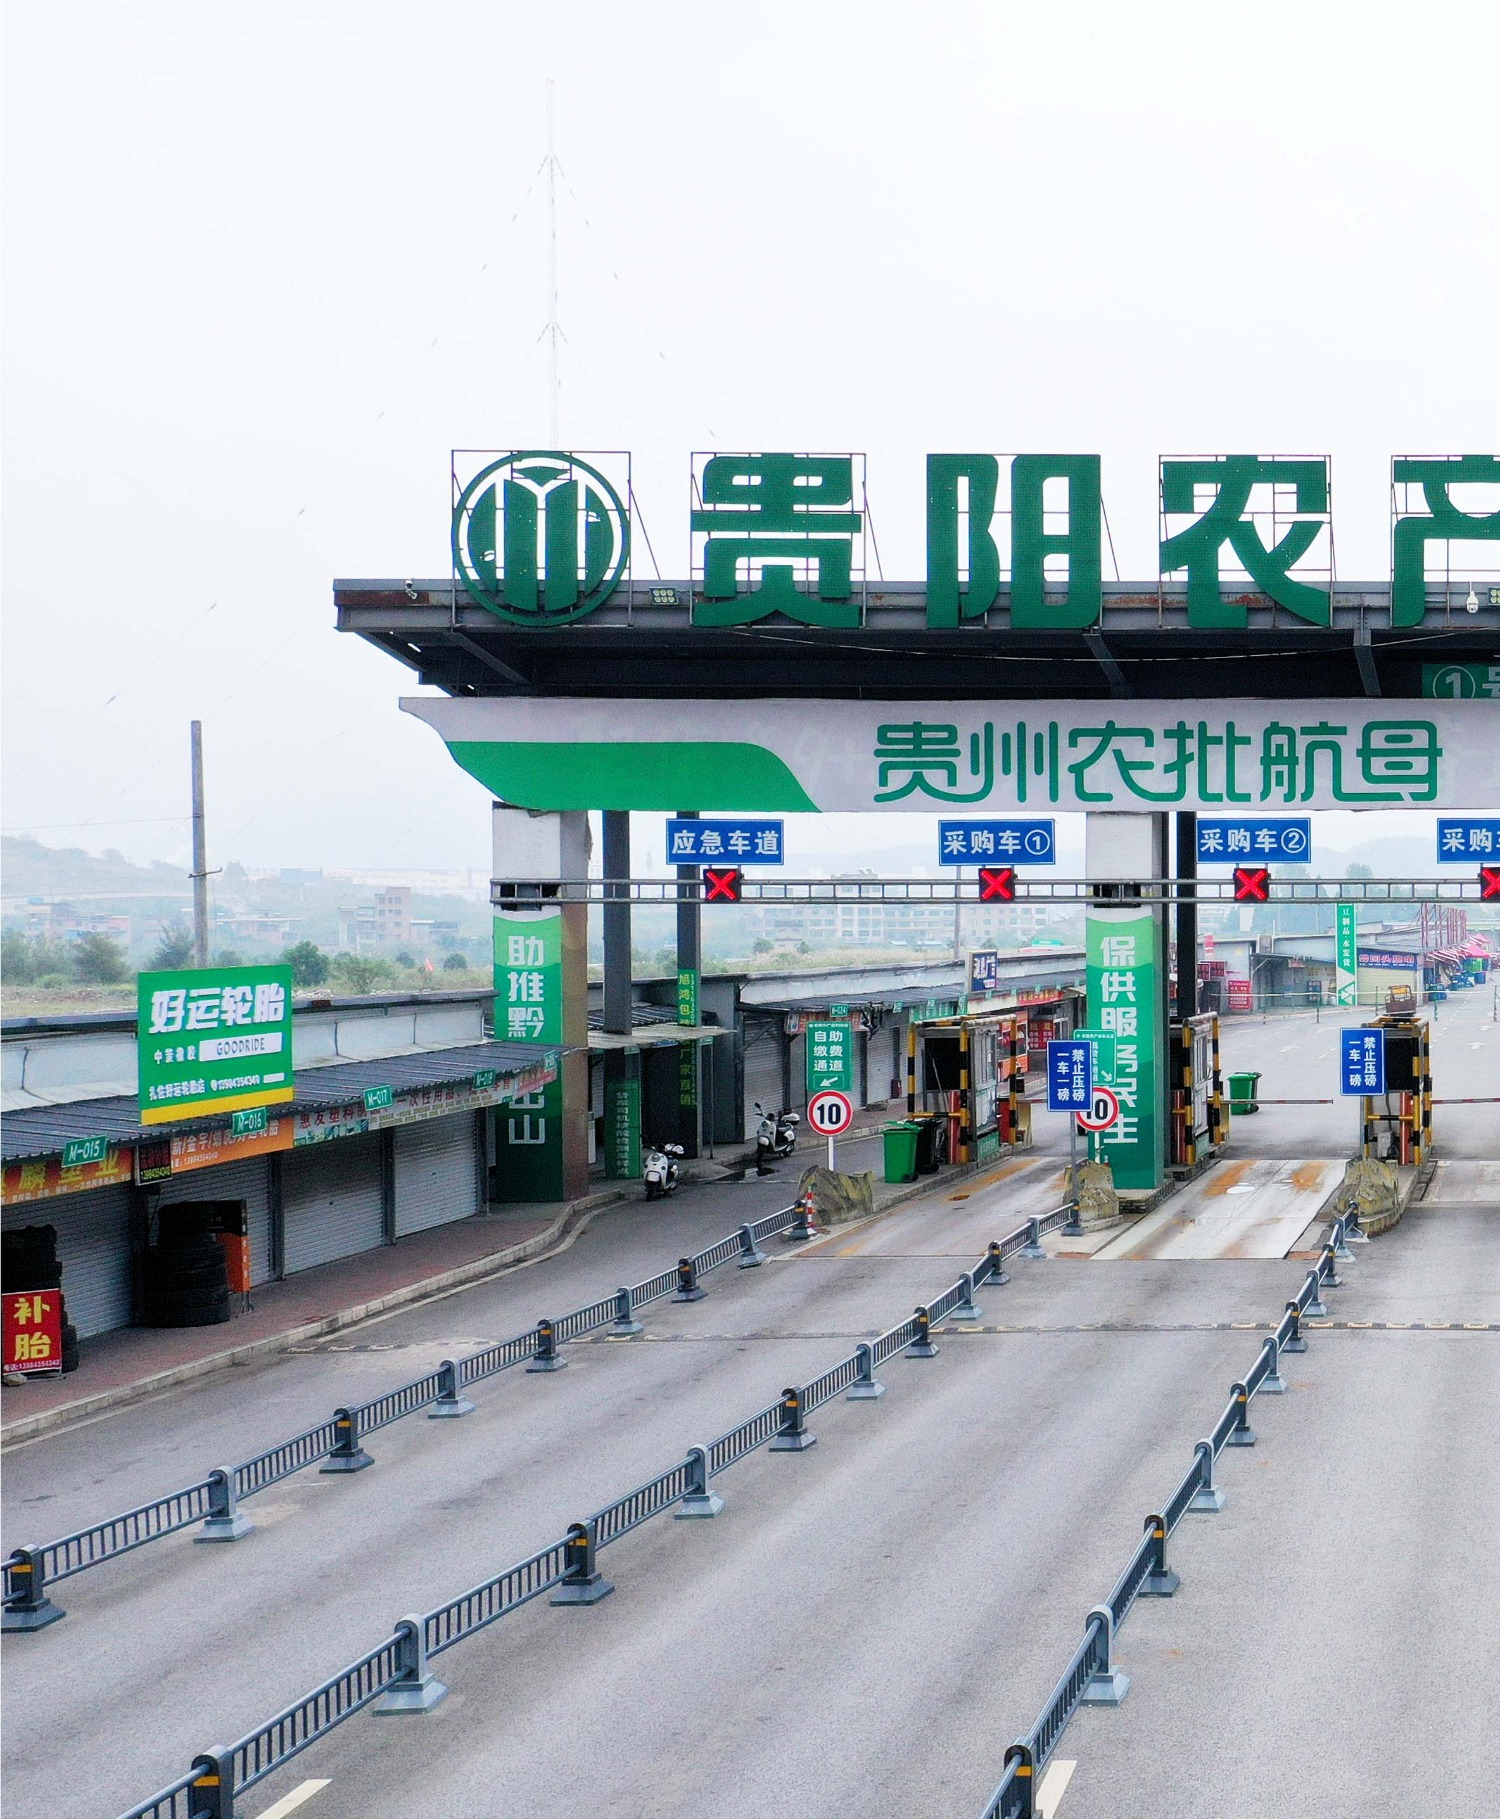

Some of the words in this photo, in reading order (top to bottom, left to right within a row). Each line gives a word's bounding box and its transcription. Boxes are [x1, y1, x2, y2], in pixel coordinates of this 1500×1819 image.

[873, 720, 1443, 803] 贵州农批航母
[671, 830, 780, 857] 应急车道
[943, 829, 1051, 857] 采购车①
[1200, 828, 1307, 855] 采购车②
[148, 983, 285, 1034] 好运轮胎
[216, 1037, 266, 1056] GOODRIDE
[506, 934, 546, 1146] 助推黔出山
[814, 1030, 843, 1042] 自助
[813, 1045, 843, 1057] 缴费
[1349, 1041, 1361, 1087] 一车一磅
[1363, 1036, 1377, 1088] 禁止压磅
[813, 1060, 844, 1072] 通道
[1057, 1052, 1070, 1102] 一车一磅
[1072, 1048, 1085, 1102] 禁止压磅
[367, 1089, 388, 1107] M-017
[816, 1102, 842, 1125] 10
[69, 1140, 100, 1162] M-015
[14, 1296, 51, 1361] 补胎
